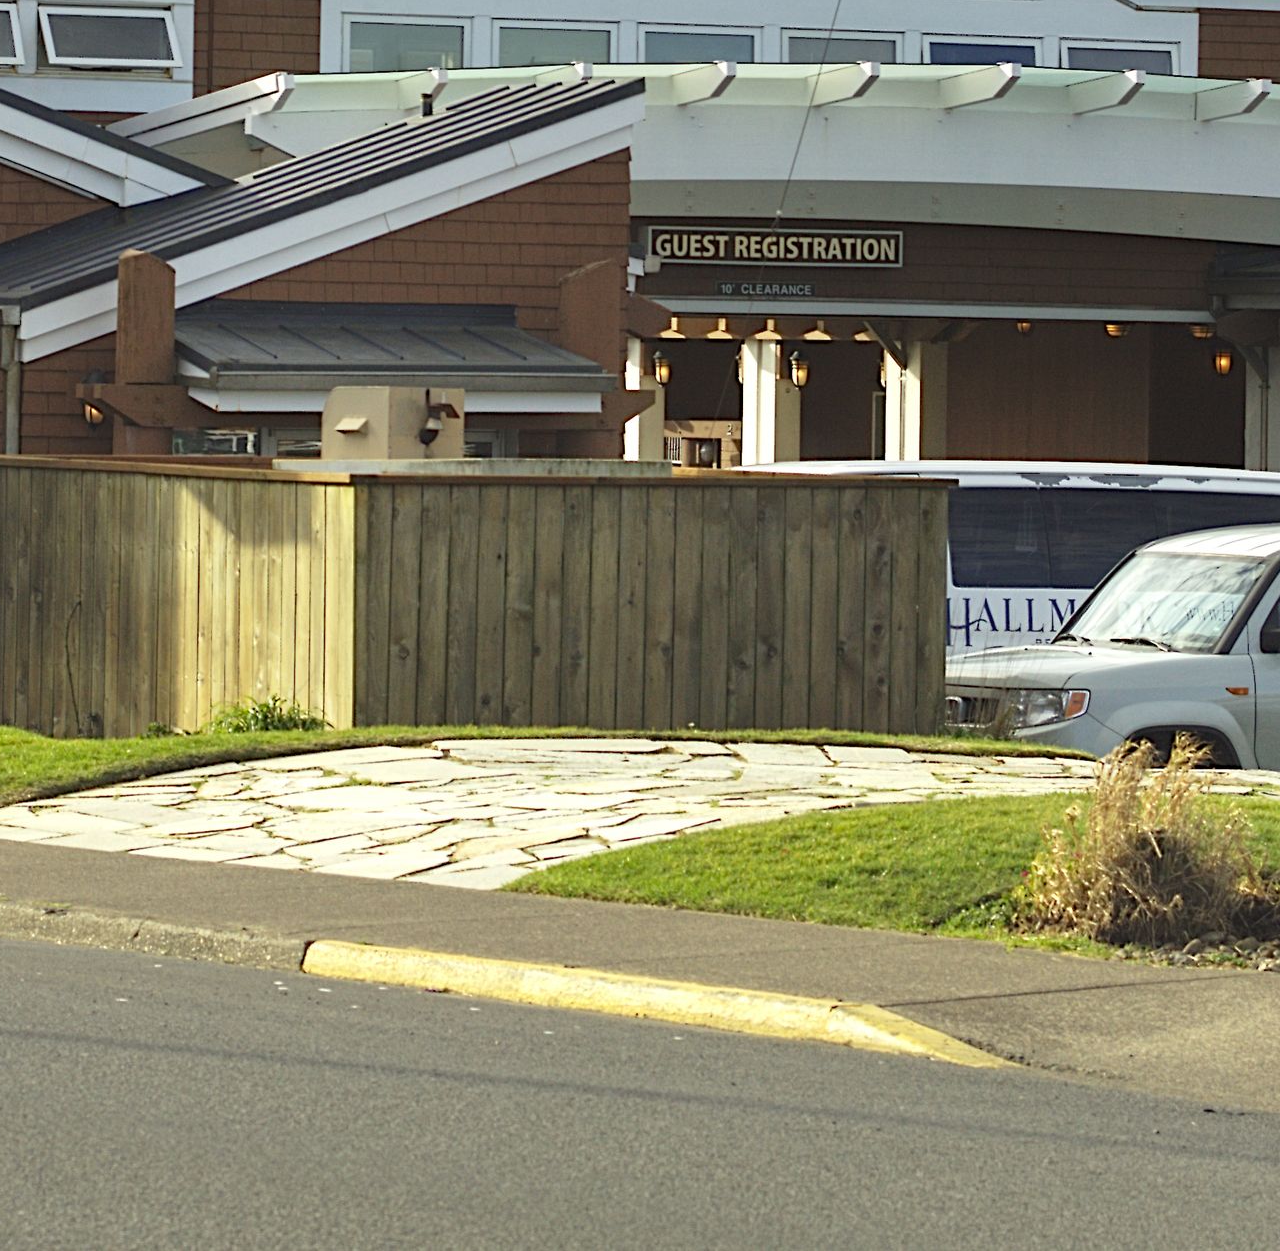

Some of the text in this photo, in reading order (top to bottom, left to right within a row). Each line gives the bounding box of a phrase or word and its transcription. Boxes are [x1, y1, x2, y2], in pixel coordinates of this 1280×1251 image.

[656, 233, 896, 261] GUEST REGISTRATION
[741, 284, 812, 296] CLEARANCE
[946, 597, 1076, 647] HALLM
